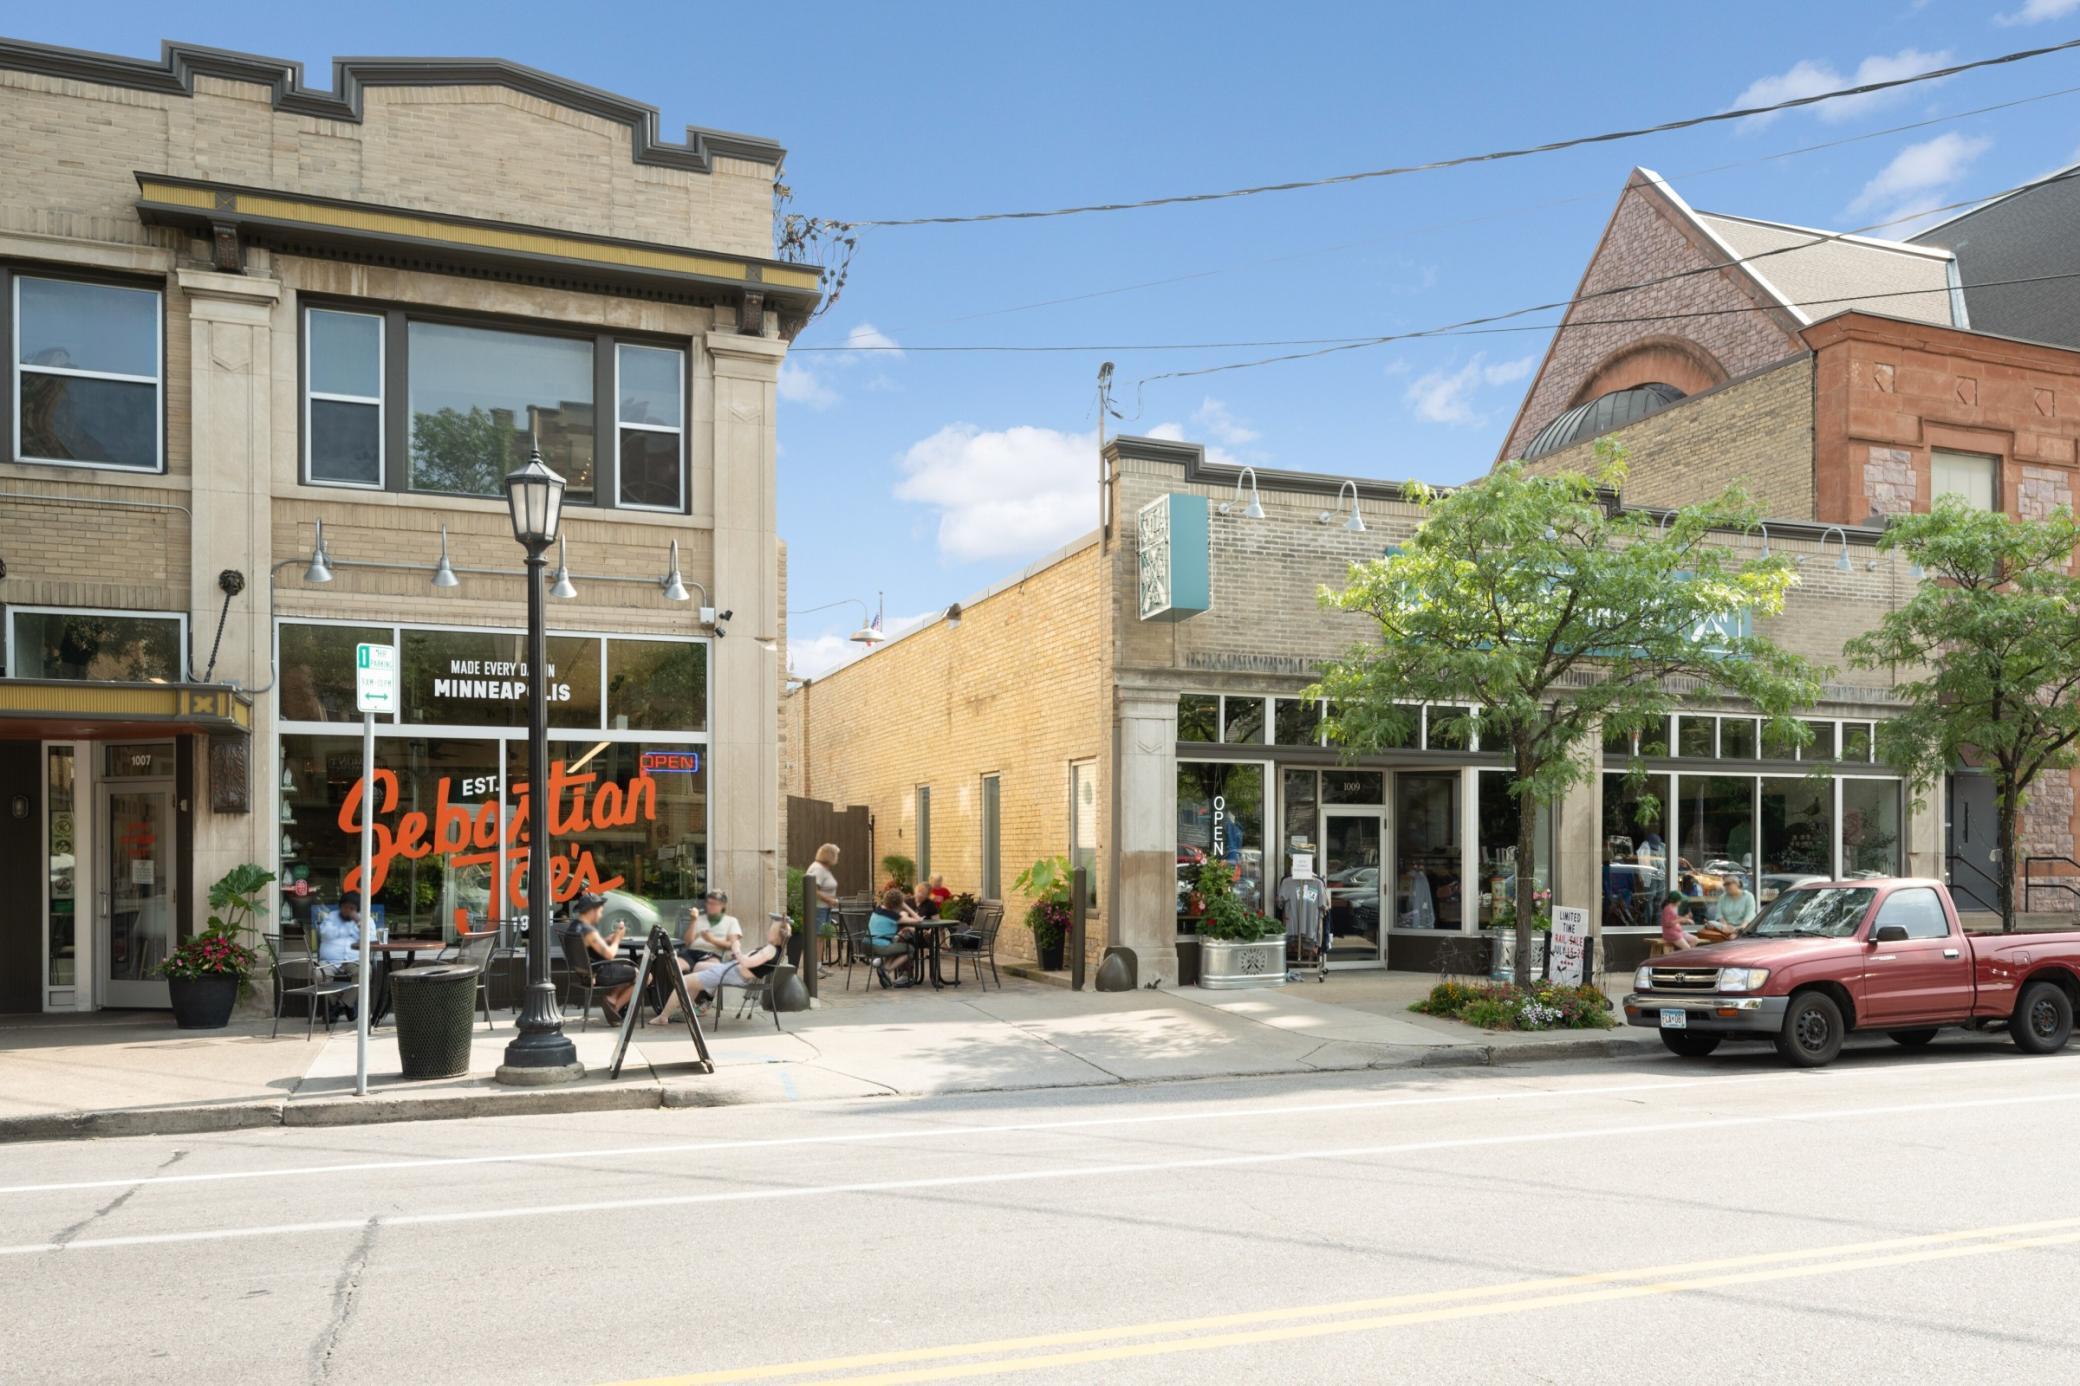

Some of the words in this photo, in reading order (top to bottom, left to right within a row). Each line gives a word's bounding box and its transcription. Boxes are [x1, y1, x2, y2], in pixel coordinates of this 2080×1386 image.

[361, 649, 367, 666] 1
[450, 660, 480, 675] MADE
[484, 661, 517, 676] EVERY
[434, 679, 571, 701] MINNEAPIS
[131, 755, 151, 766] 1007
[640, 755, 694, 769] OPEN
[462, 776, 500, 797] EST.
[1343, 782, 1361, 791] 1009
[338, 759, 656, 896] Sebastian
[1213, 795, 1225, 856] OPEN
[1559, 911, 1582, 923] LIMITED
[1563, 922, 1576, 934] TIME
[1569, 935, 1583, 947] SALE
